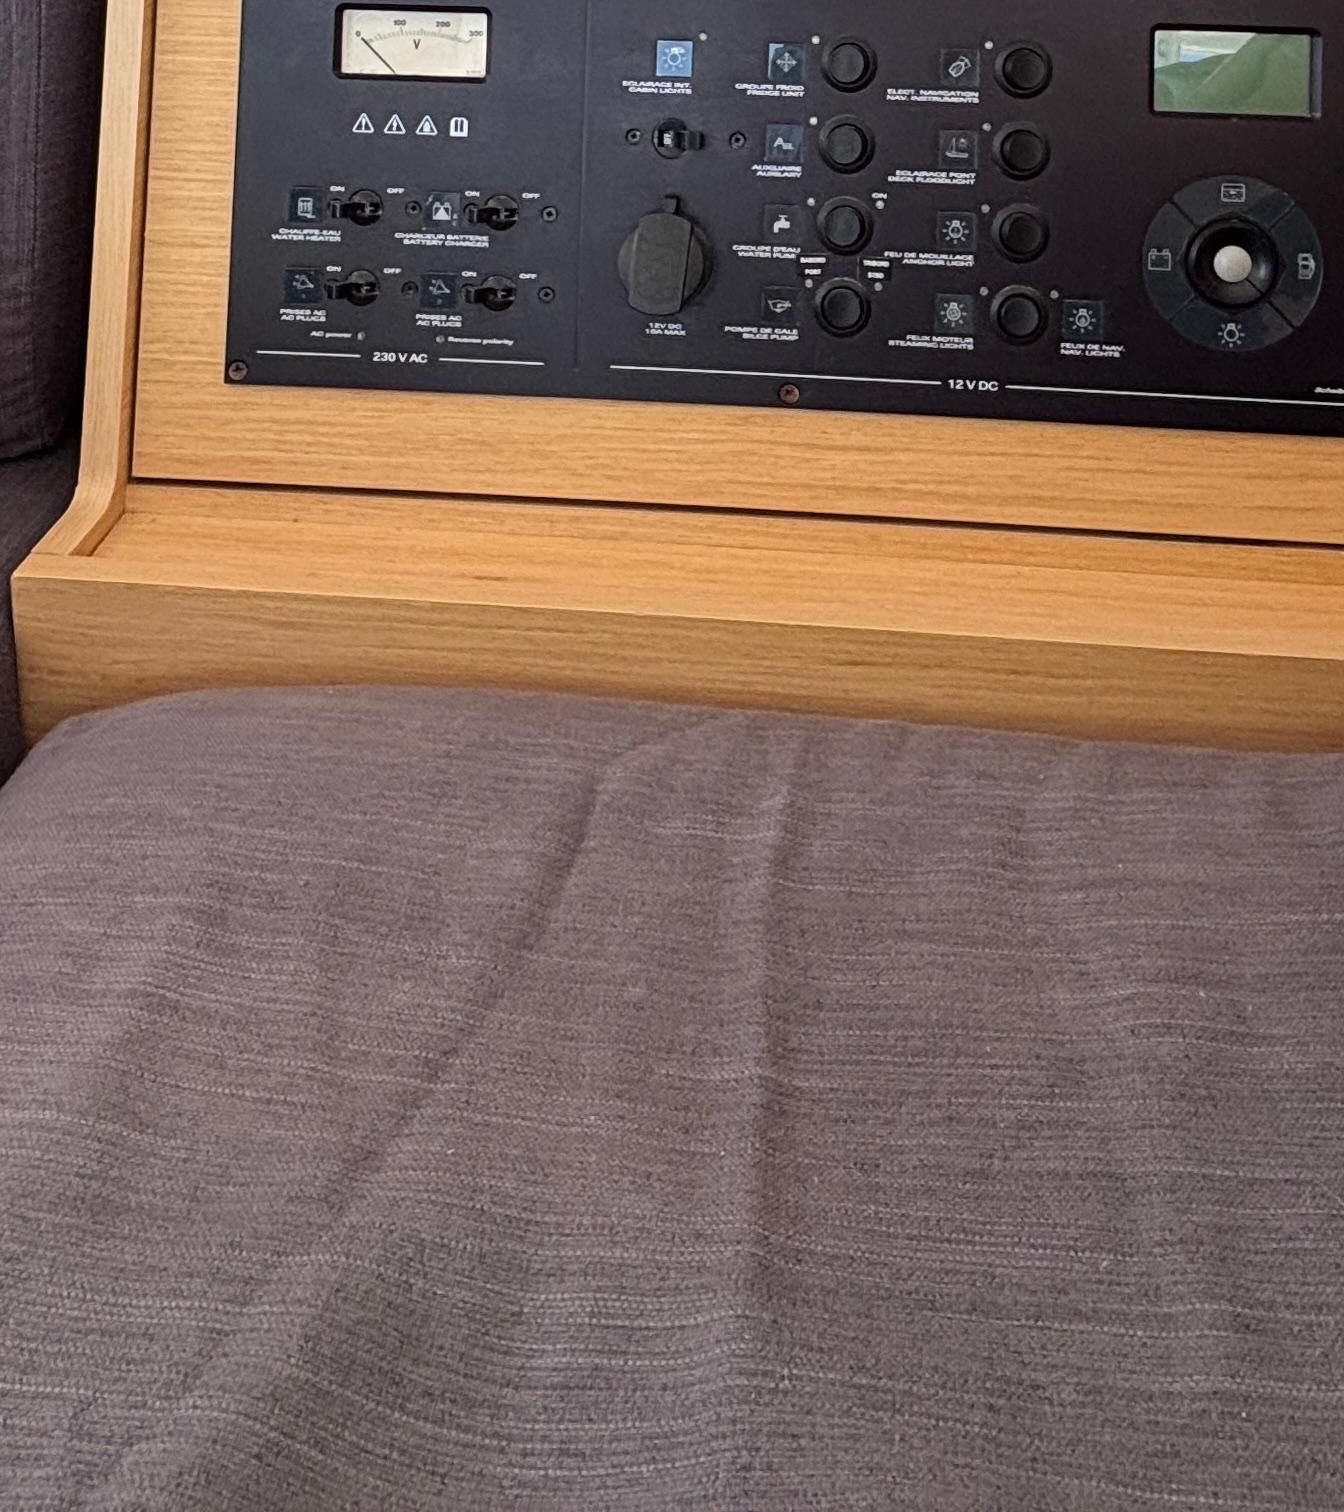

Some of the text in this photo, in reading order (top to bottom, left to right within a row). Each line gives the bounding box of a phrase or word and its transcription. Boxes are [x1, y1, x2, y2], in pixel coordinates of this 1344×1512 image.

[413, 38, 421, 50] V
[659, 87, 692, 95] LIGHTS
[871, 192, 888, 200] ON
[403, 238, 489, 248] BATTERY CHARGER
[724, 325, 758, 333] POMPE
[482, 338, 514, 346] polarity
[906, 334, 974, 344] FEUX MOTEUR
[888, 339, 974, 350] STEAMING LIGHTS
[1060, 342, 1125, 352] FEUX DE NAV.
[372, 351, 428, 363] 230 V AC
[1060, 348, 1120, 358] NAV. LIGHTS
[948, 379, 999, 391] 12 V DC
